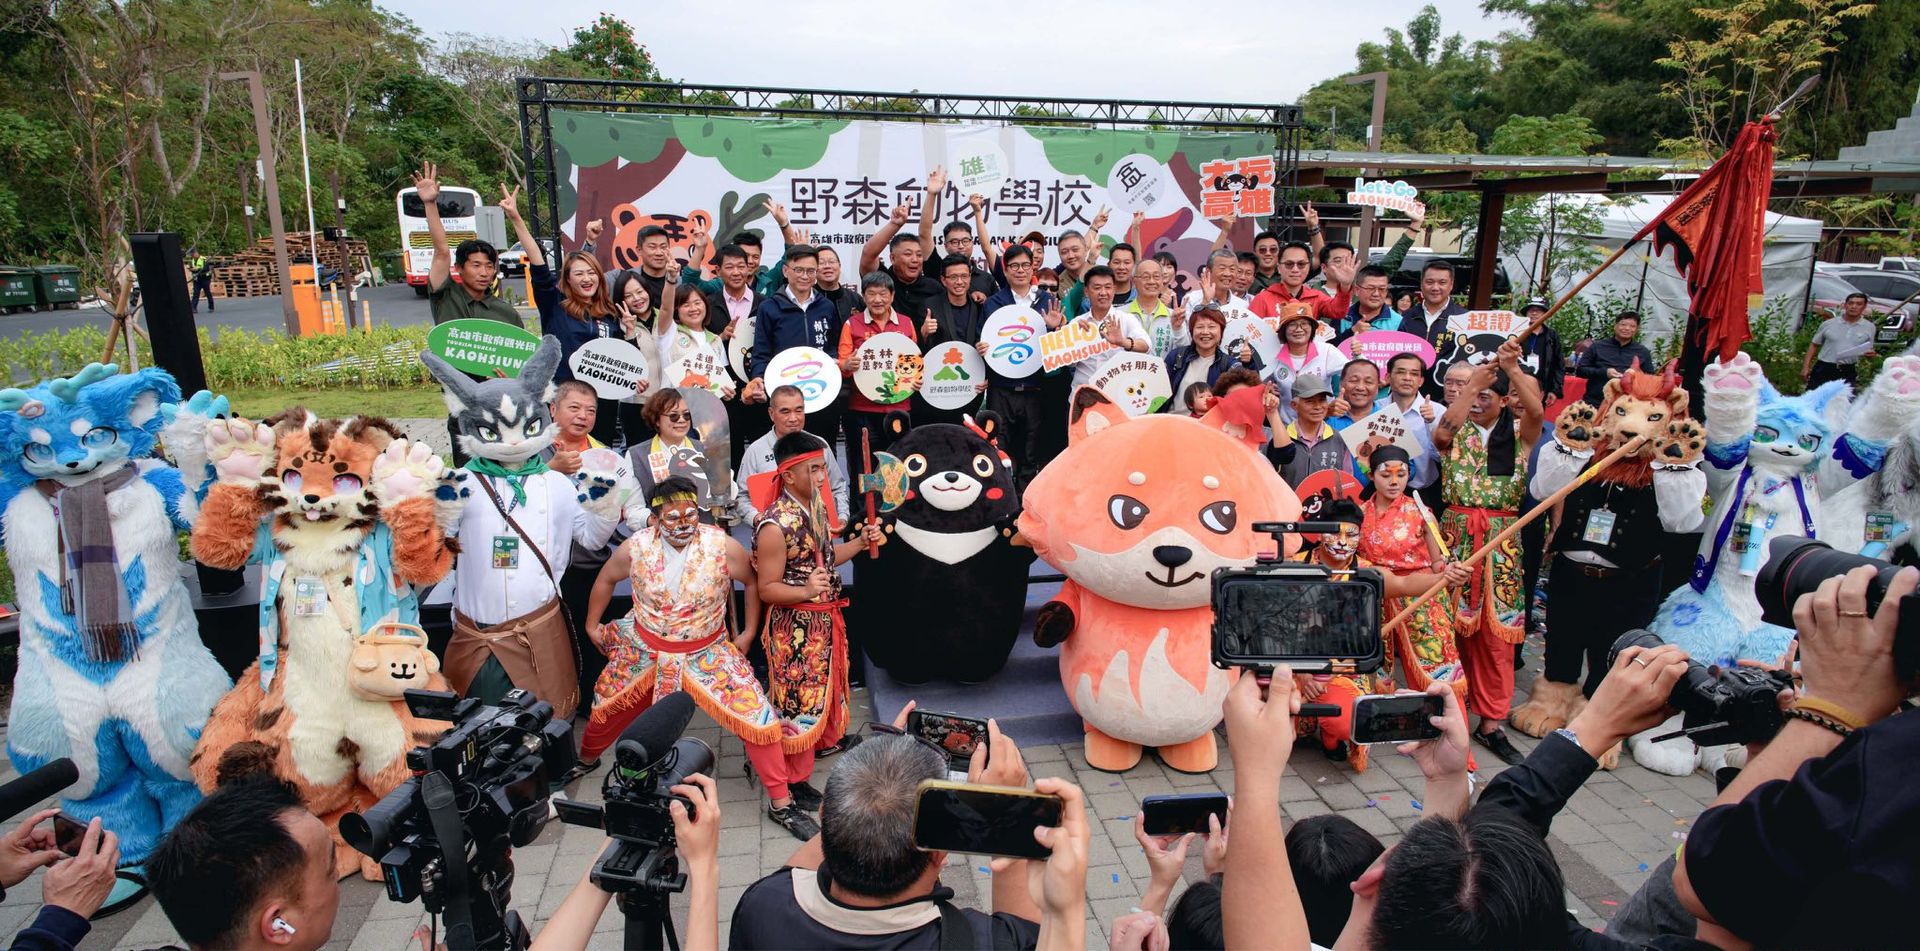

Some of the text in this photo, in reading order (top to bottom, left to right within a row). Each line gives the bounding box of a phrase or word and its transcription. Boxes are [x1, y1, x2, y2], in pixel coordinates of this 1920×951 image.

[1467, 313, 1512, 331] 超讚
[447, 339, 497, 352] TOURISM BUREAU
[448, 327, 537, 353] 高雄市政府觀光局
[1041, 322, 1098, 356] HELLO
[582, 349, 644, 375] 高雄市政府觀光局
[863, 348, 893, 361] 森林
[580, 359, 626, 377] TOURISM BUREAU
[683, 359, 724, 376] 森林學習
[863, 360, 893, 371] 是教室
[576, 364, 637, 391] KAOHSIUNG
[1096, 361, 1159, 390] 動物好朋友
[1367, 421, 1405, 437] 動物課
[1377, 414, 1401, 426] 森林
